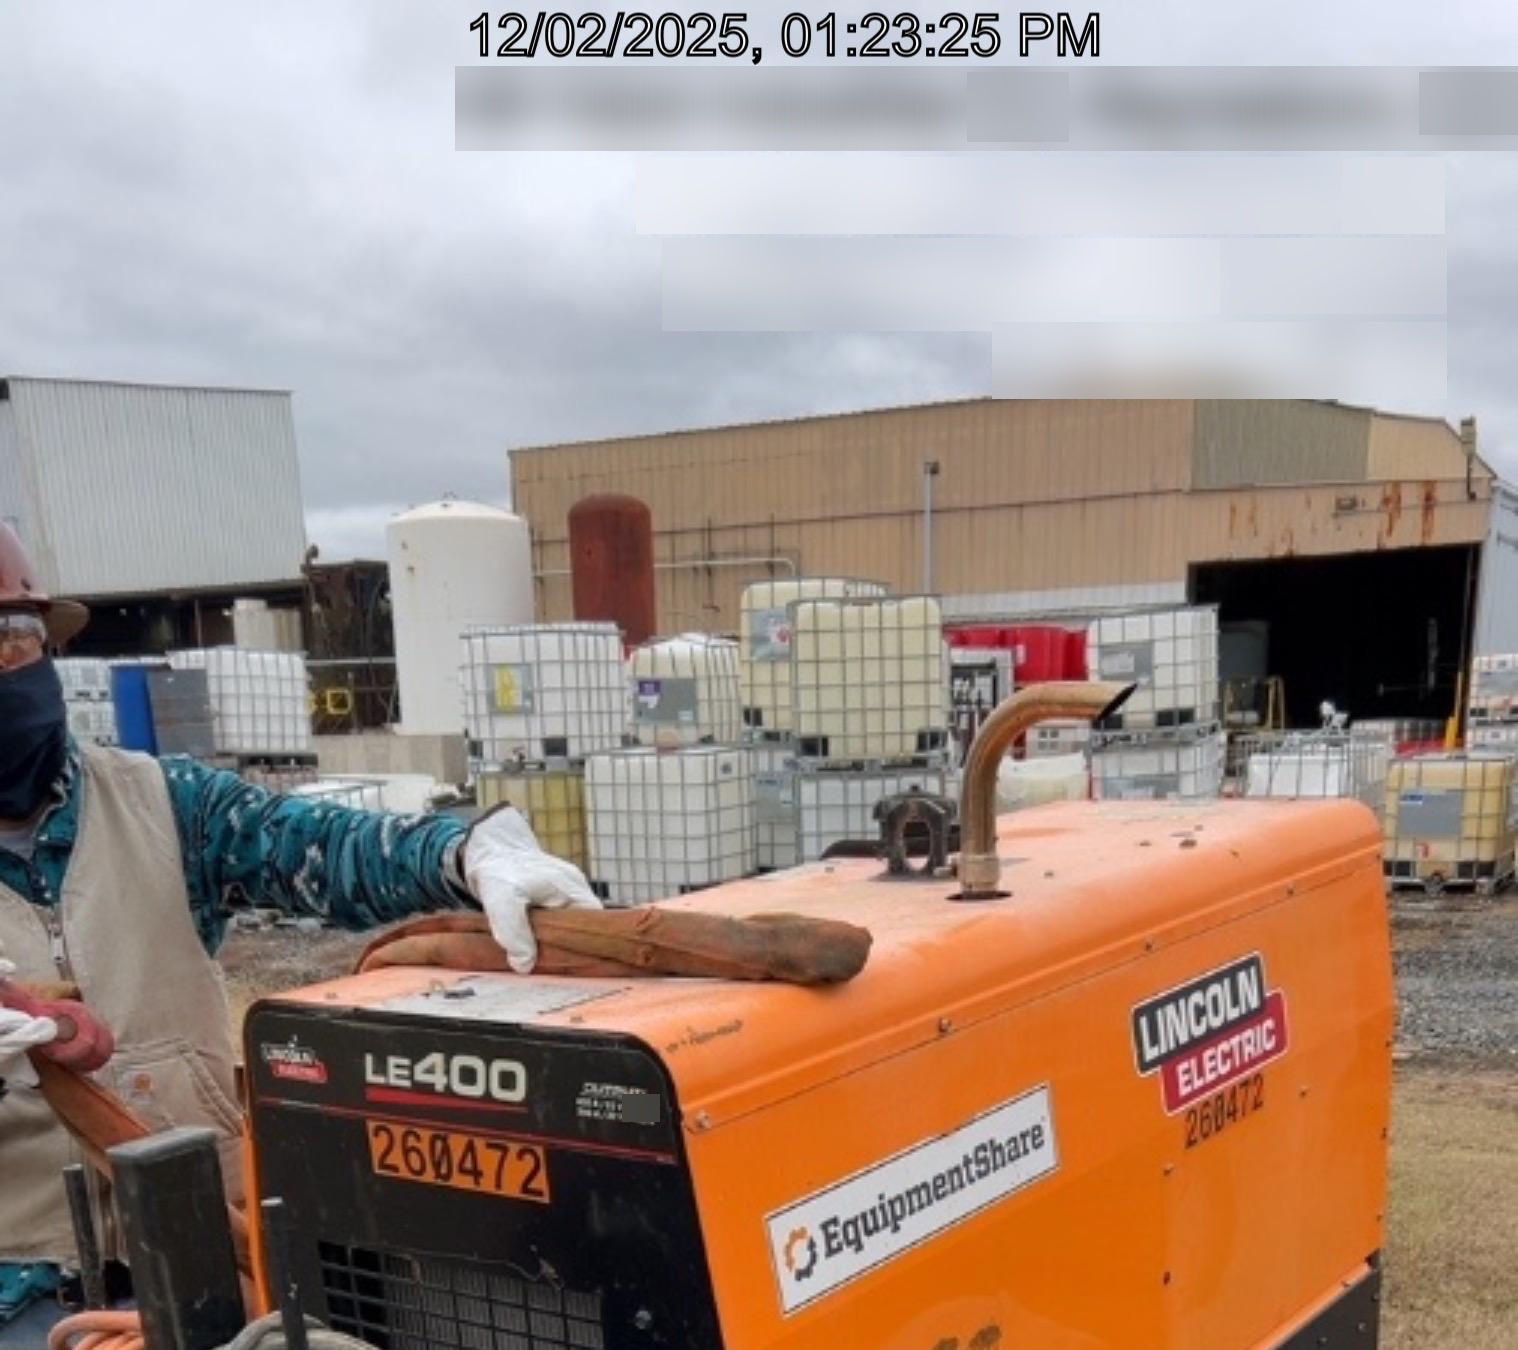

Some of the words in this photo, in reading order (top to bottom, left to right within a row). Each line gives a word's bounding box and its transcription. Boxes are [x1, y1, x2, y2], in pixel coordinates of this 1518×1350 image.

[1139, 965, 1261, 1063] LINCOLN
[365, 1052, 527, 1102] LE400
[1177, 1017, 1276, 1097] ELECTRIC
[1184, 1072, 1264, 1150] 260472
[373, 1123, 544, 1198] 260472
[819, 1123, 1045, 1258] EquipmentShare
